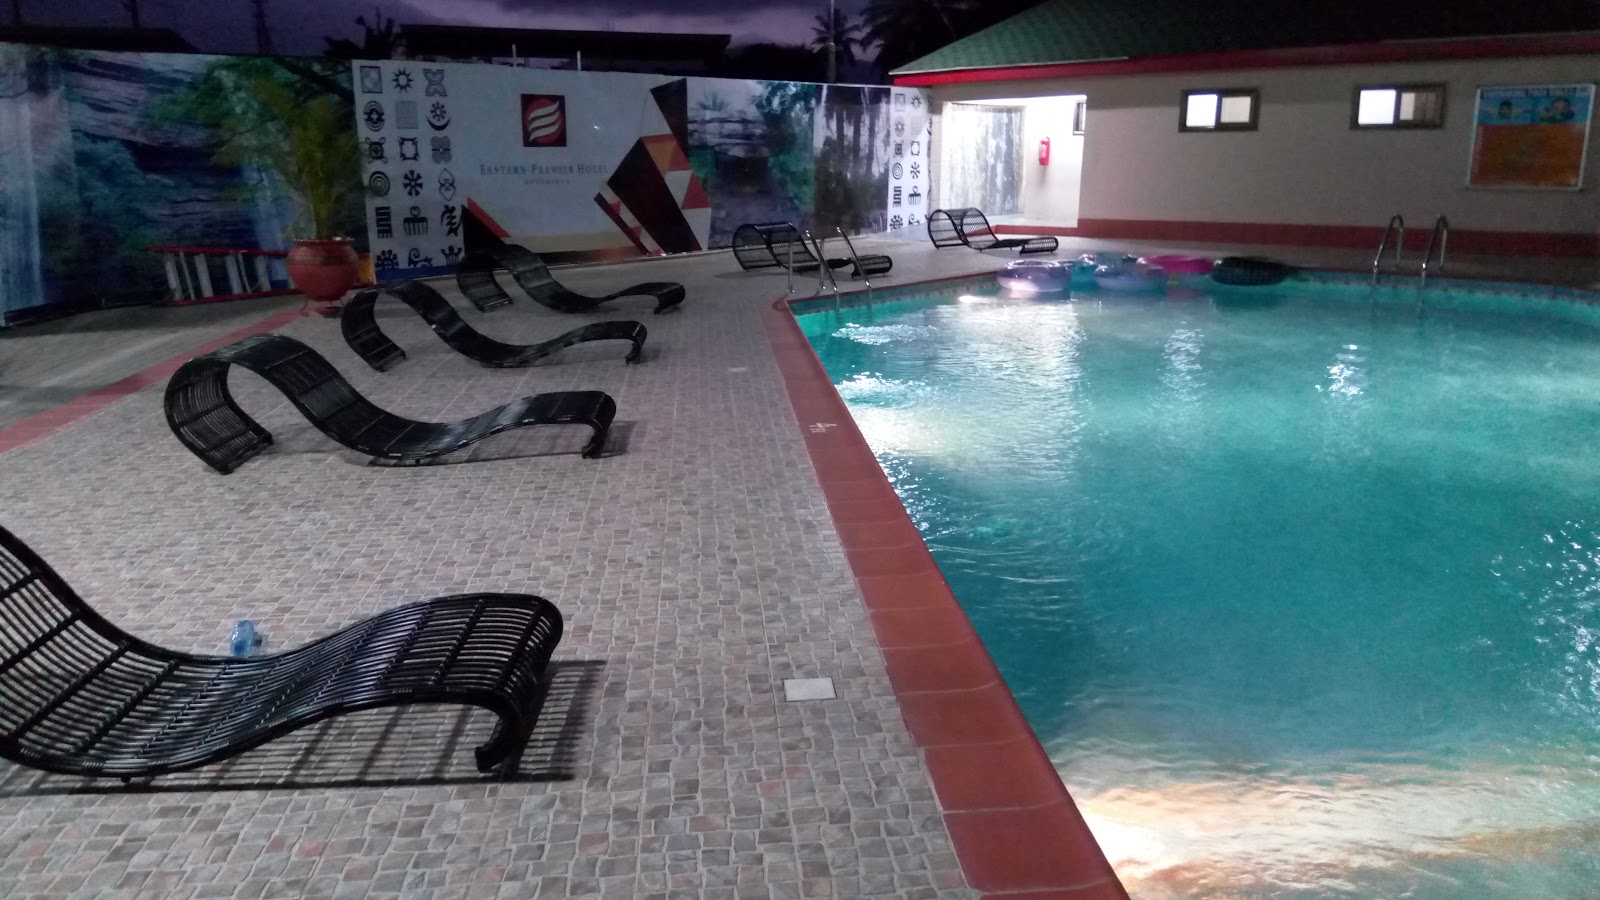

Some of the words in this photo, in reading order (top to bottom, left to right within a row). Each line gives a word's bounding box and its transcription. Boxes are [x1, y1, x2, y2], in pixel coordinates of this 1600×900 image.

[480, 163, 527, 175] EASTERN
[531, 163, 575, 175] PREMIER
[577, 163, 609, 174] HOTEL
